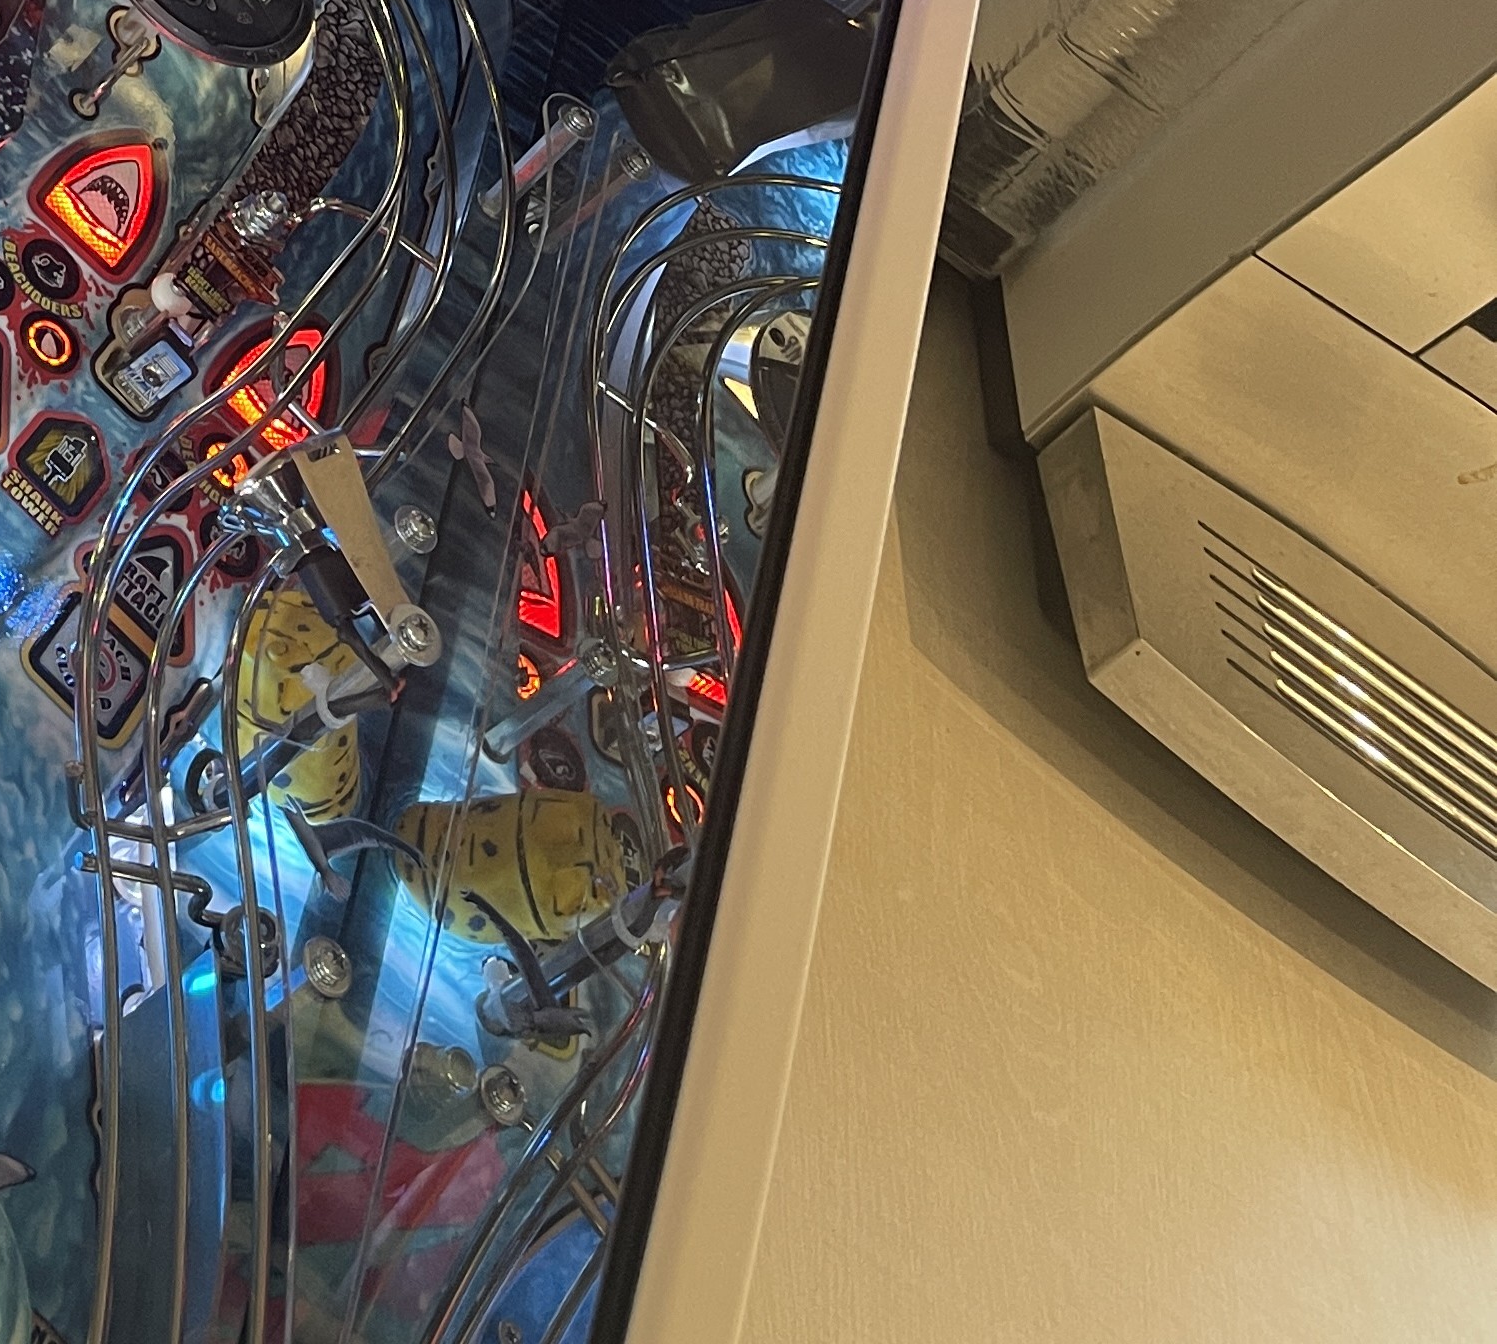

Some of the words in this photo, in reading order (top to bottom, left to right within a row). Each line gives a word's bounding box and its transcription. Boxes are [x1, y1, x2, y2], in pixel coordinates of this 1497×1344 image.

[3, 240, 83, 318] BEACHGOERS
[3, 482, 59, 537] TOWER
[10, 468, 65, 526] SHARK
